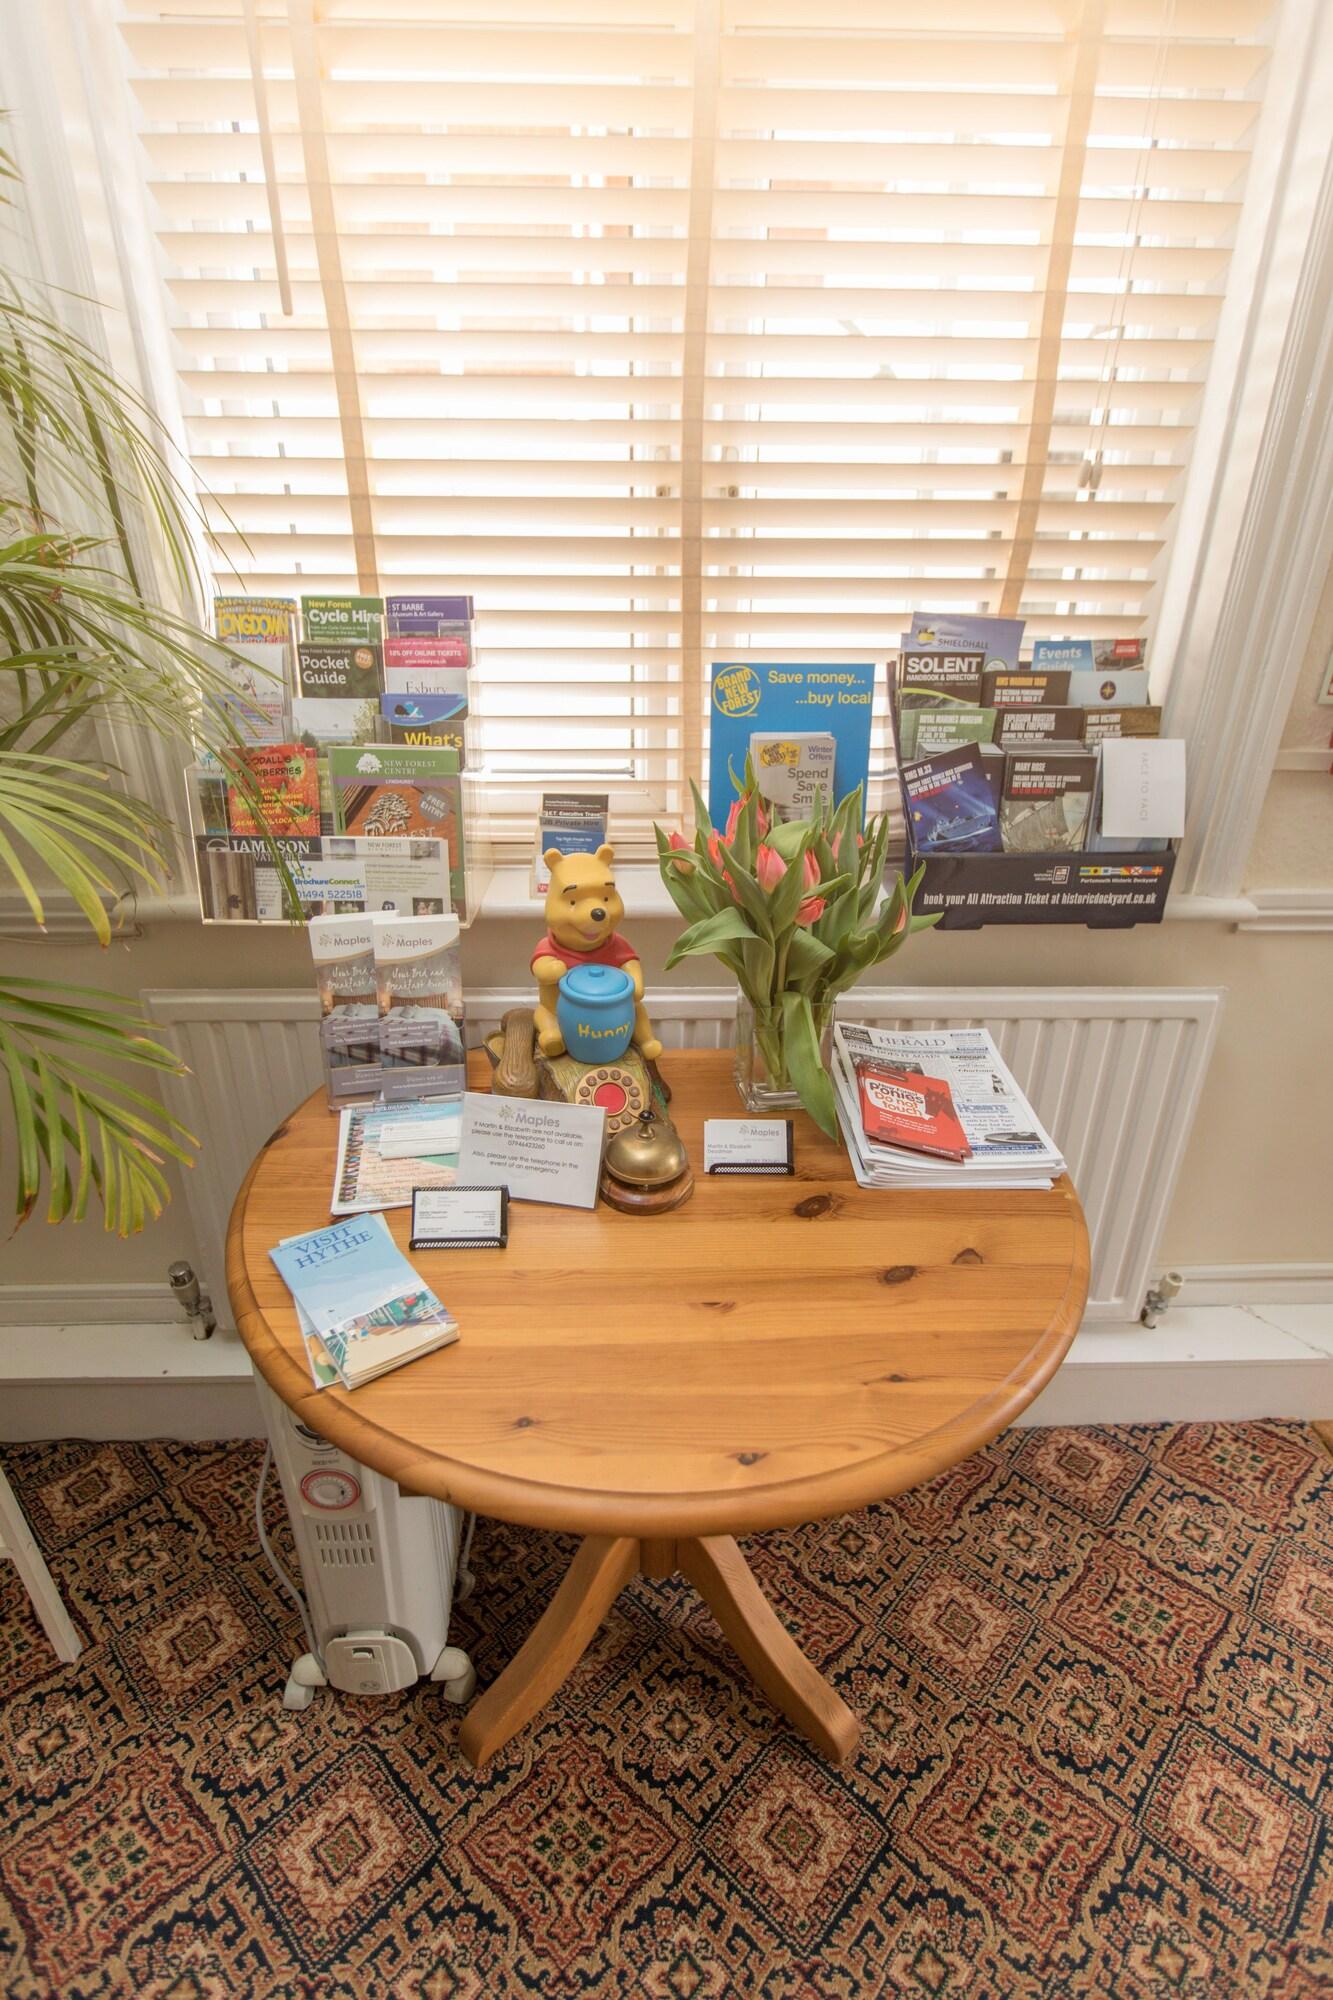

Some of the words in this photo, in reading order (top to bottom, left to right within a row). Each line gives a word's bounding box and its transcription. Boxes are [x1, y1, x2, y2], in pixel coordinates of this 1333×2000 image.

[309, 600, 326, 608] New
[392, 603, 400, 611] ST
[402, 603, 424, 611] BARBE
[309, 609, 348, 624] Cycle
[352, 610, 381, 623] Hire
[938, 638, 989, 649] SHIELDHALL
[1038, 648, 1082, 659] Events
[301, 655, 350, 670] Pocket
[907, 656, 981, 673] SOLENT
[303, 671, 346, 684] Guide
[717, 670, 752, 690] BRAND
[768, 669, 802, 684] Save
[807, 672, 865, 686] money...
[725, 682, 749, 699] NEW
[721, 690, 760, 712] FOREST
[796, 692, 834, 707] ...buy
[838, 691, 871, 704] local
[404, 732, 463, 748] What's
[788, 768, 829, 780] Spend
[427, 794, 446, 810] FREE
[792, 793, 827, 804] Sme
[420, 801, 445, 819] ENTRY
[327, 890, 362, 899] 522518
[923, 893, 944, 905] book
[944, 894, 965, 907] your
[966, 893, 978, 905] All
[978, 893, 1021, 905] Attraction
[1023, 893, 1049, 905] Ticket
[1051, 893, 1060, 904] at
[1061, 892, 1157, 906] historicdockyard.co.uk
[334, 936, 371, 948] Maples
[396, 938, 433, 948] Maples
[578, 1023, 630, 1039] Hunny
[879, 1036, 946, 1047] HERALD
[869, 1082, 924, 1104] Ponies
[875, 1091, 893, 1102] Do
[896, 1098, 919, 1109] not
[479, 1122, 498, 1130] Martin
[504, 1124, 531, 1134] Elizabeth
[515, 1112, 560, 1128] Maples
[472, 1128, 491, 1137] please
[515, 1133, 546, 1144] telephone
[750, 1129, 781, 1137] Maples
[486, 1151, 507, 1162] please
[530, 1156, 561, 1168] telephone
[568, 1161, 579, 1169] the
[490, 1159, 508, 1168] event
[524, 1164, 559, 1175] emergency
[294, 1225, 353, 1255] VISIT
[295, 1230, 374, 1269] HYTHE
